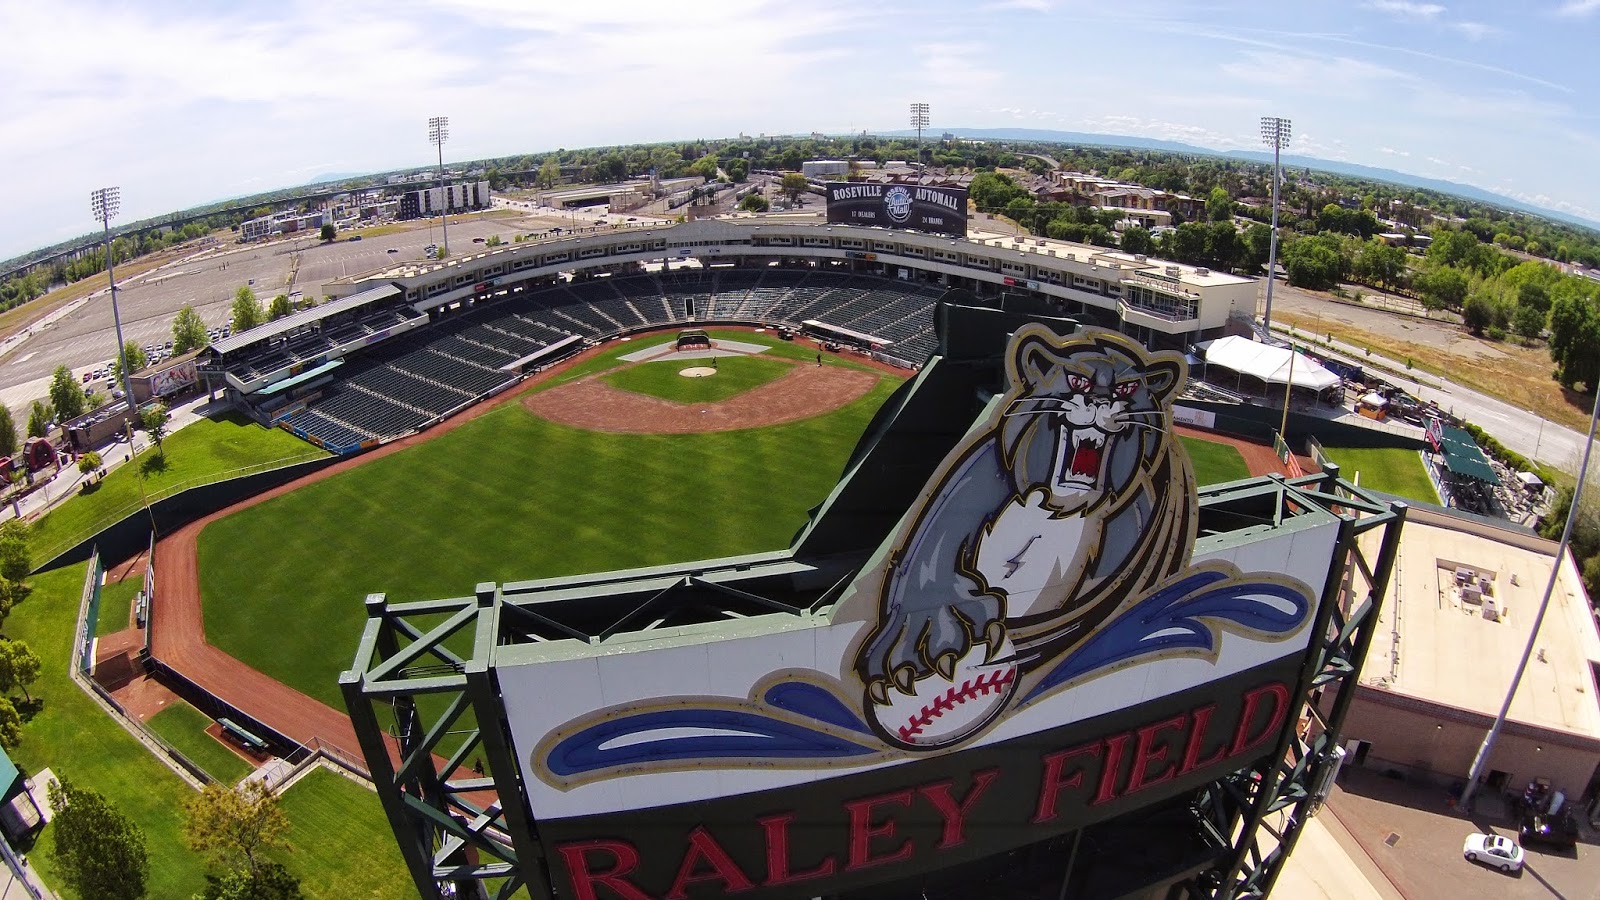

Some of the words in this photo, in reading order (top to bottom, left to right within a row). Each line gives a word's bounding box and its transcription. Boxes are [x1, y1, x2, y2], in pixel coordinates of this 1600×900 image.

[833, 185, 882, 200] ROSEVILLE
[915, 188, 958, 211] AUTOMALL
[893, 204, 908, 215] Mall
[922, 216, 928, 224] 24
[556, 768, 999, 900] RALEY
[1031, 681, 1291, 825] FIELD
